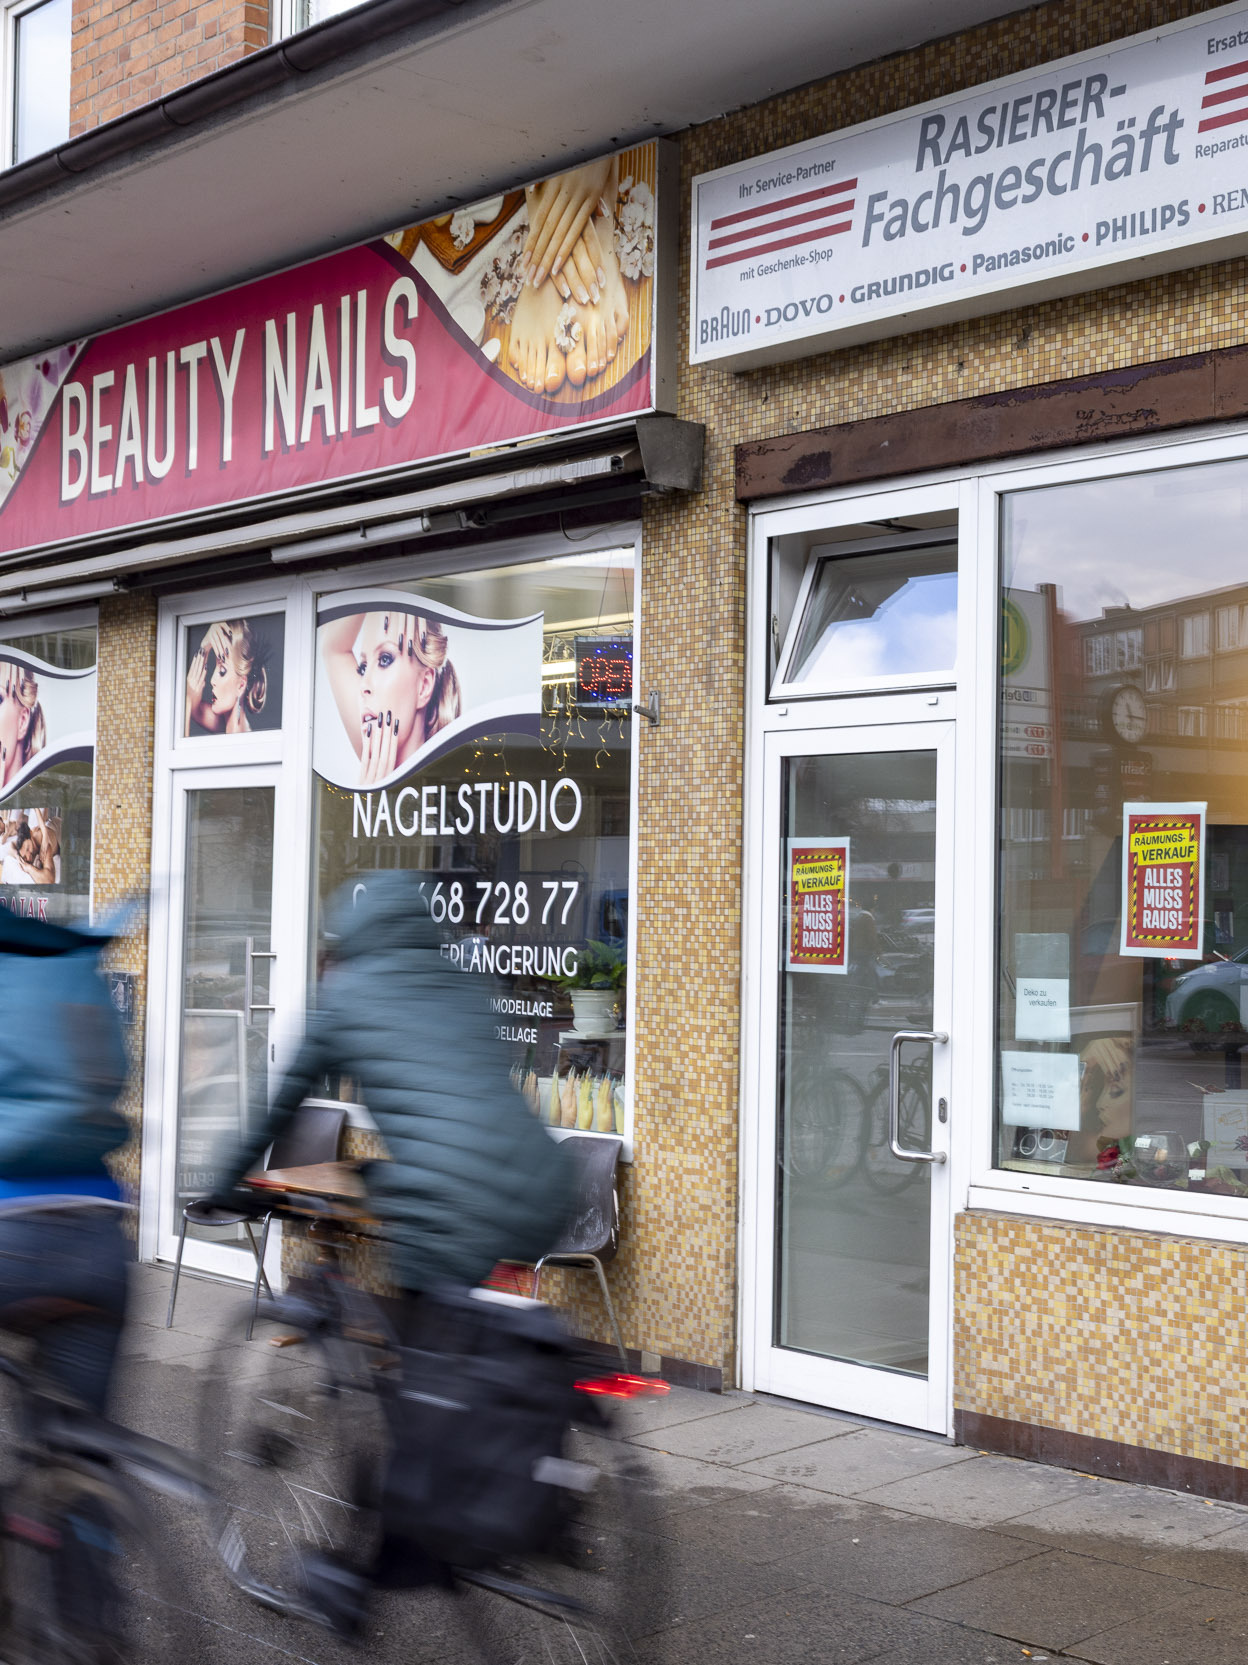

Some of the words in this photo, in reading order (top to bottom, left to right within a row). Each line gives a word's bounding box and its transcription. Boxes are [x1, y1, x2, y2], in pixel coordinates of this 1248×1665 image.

[915, 72, 1127, 173] RASIERER-
[738, 181, 754, 199] Ihr
[755, 158, 836, 194] Service-Partner
[861, 104, 1185, 248] Fachgeschäft
[739, 267, 755, 282] mit
[756, 247, 833, 278] Geschenke-Shop
[764, 293, 833, 327] DOVO
[850, 262, 955, 304] GRUNDIG
[972, 232, 1075, 275] Panasonic
[1095, 199, 1190, 246] PHILIPS
[60, 328, 246, 502] BEAUTY
[264, 276, 419, 452] NAILS
[579, 657, 632, 692] OPE
[352, 777, 583, 838] NAGELSTUDIO
[1134, 832, 1186, 847] RÄUMUNGS-
[1142, 844, 1195, 861] VERKAUF
[795, 863, 835, 877] RÄUMUNGS-
[1144, 868, 1182, 887] ALLES
[801, 873, 842, 890] VERKAUF
[475, 881, 530, 925] 728
[541, 881, 579, 925] 77
[803, 894, 833, 912] ALLES
[1143, 889, 1182, 908] MUSS
[803, 913, 833, 931] MUSS
[1142, 910, 1183, 930] RAUS!
[802, 931, 833, 949] RAUS!
[439, 937, 578, 977] ERLÄNGERUNG
[1023, 987, 1039, 997] Deko
[489, 998, 553, 1018] MODELLAGE
[1028, 998, 1057, 1008] verkaufen
[495, 1026, 538, 1044] DELLAGE
